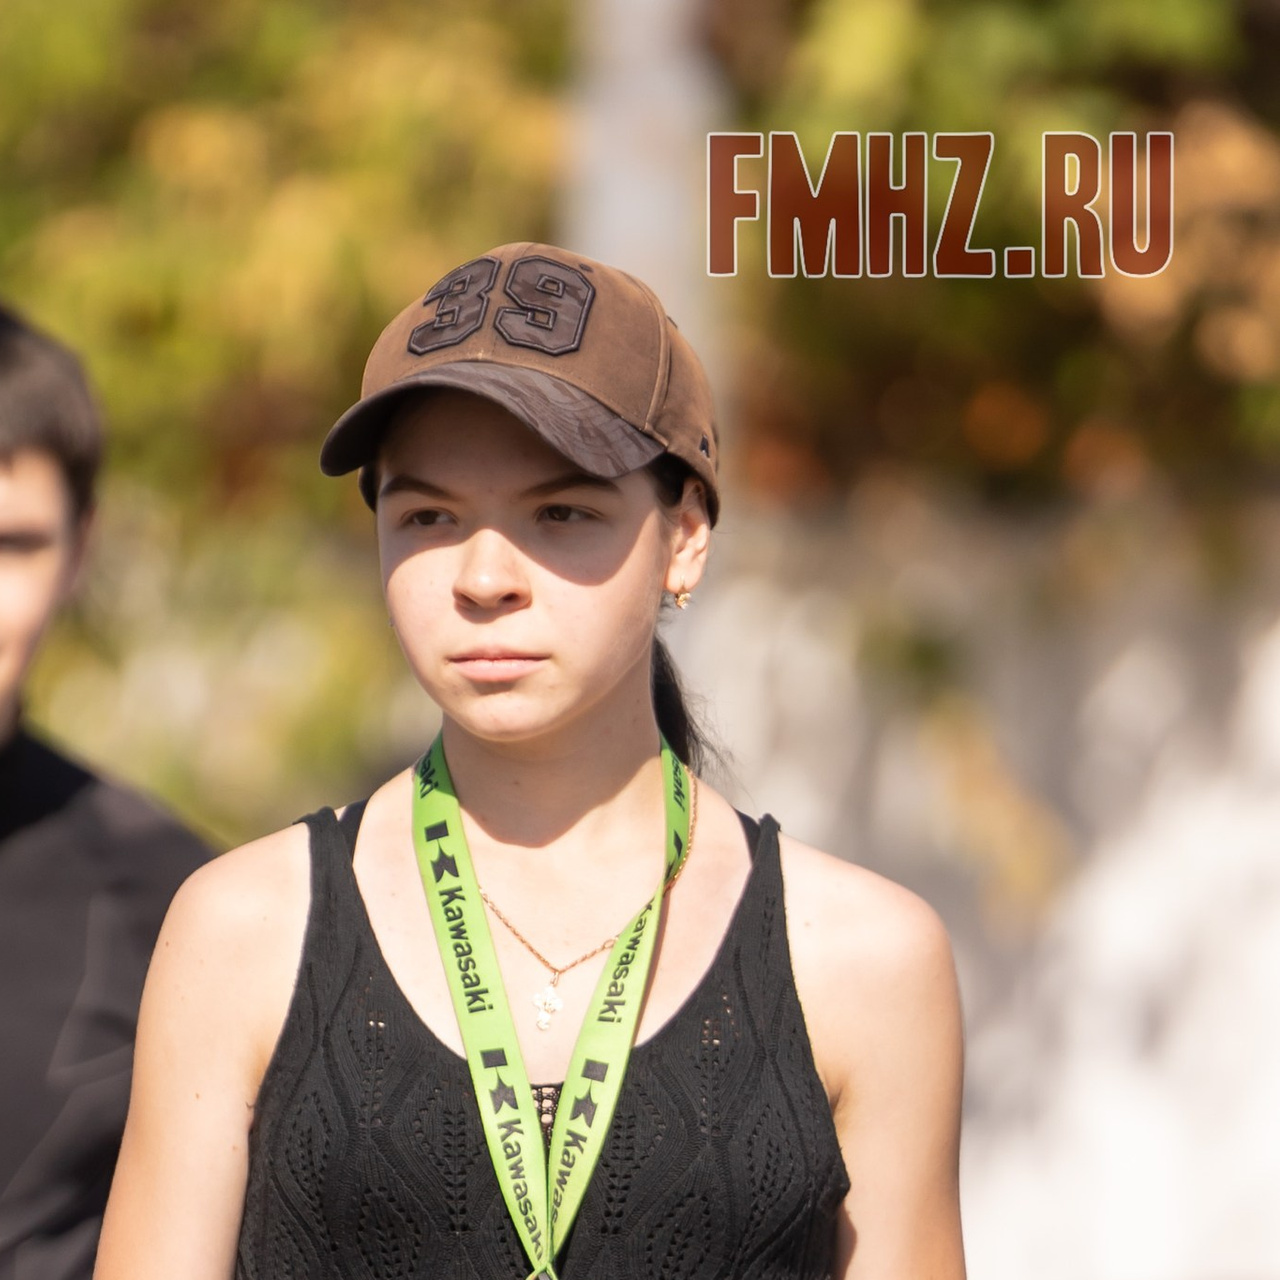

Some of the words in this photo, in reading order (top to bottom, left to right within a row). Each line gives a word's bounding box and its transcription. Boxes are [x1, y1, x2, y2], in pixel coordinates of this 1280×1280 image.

[408, 255, 596, 356] 39
[438, 886, 494, 1013] Kawasaki
[497, 1118, 543, 1261] Kawasaki
